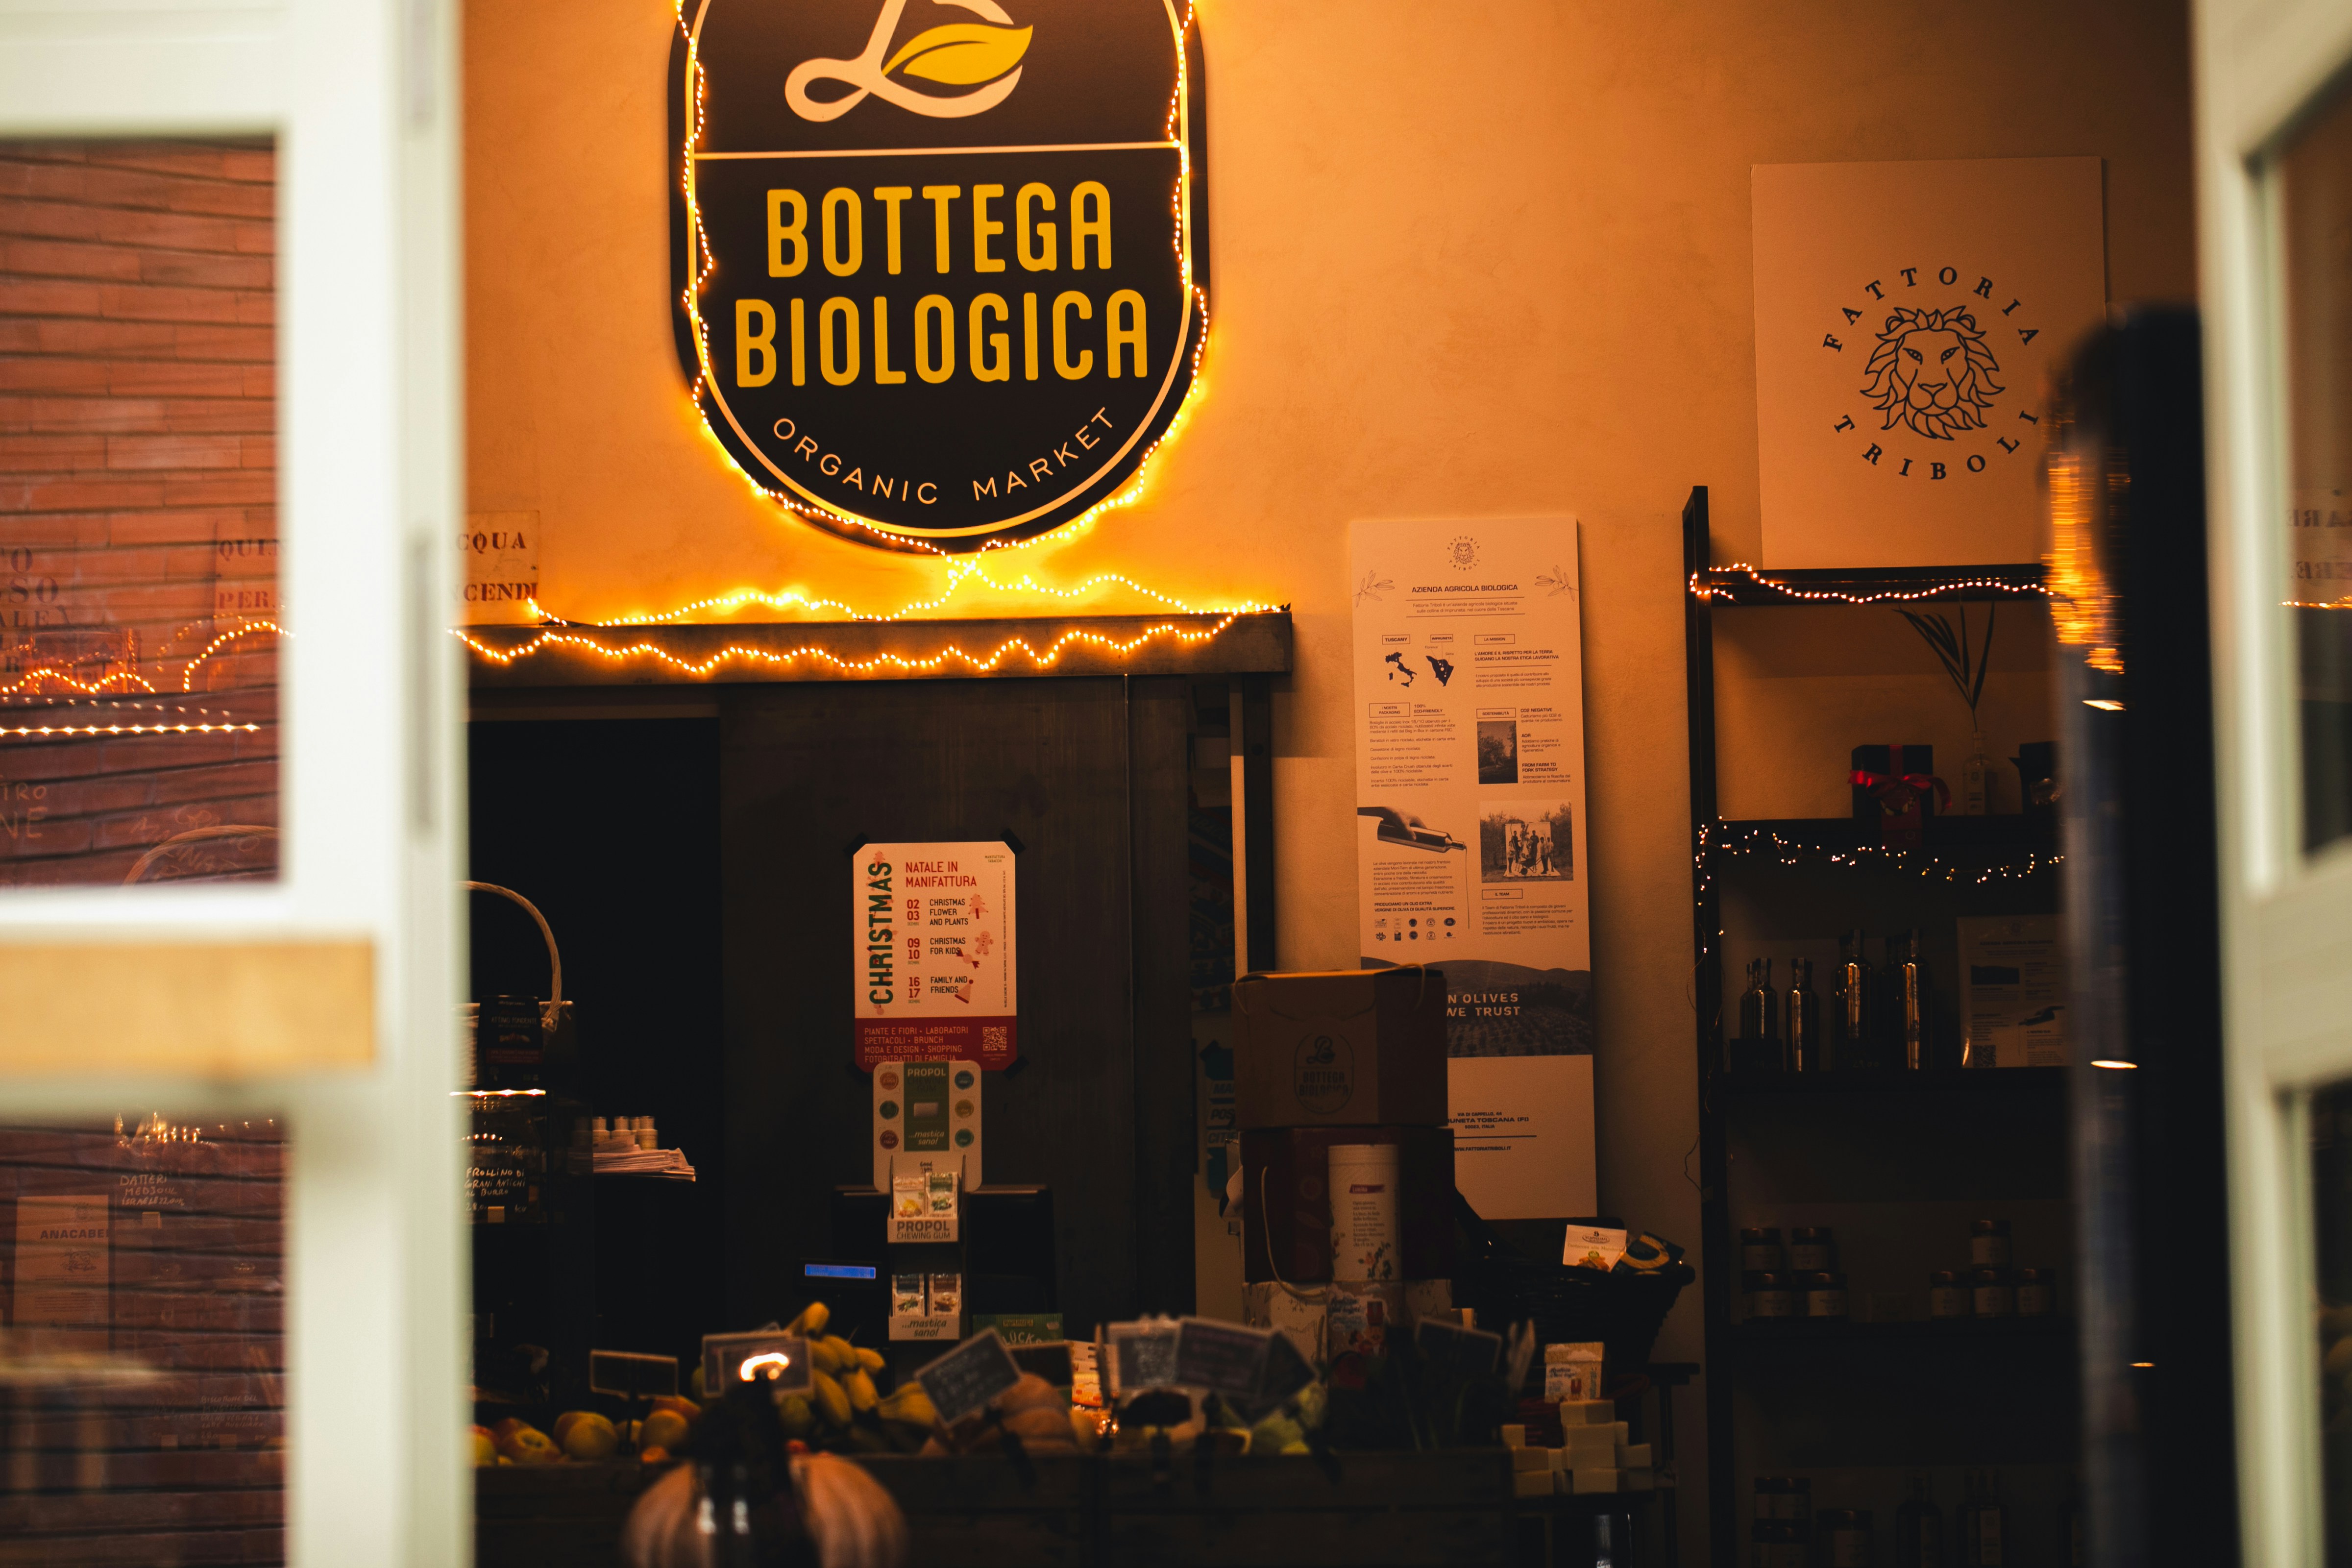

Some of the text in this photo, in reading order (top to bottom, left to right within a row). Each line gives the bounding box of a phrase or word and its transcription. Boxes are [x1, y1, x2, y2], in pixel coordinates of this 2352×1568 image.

[766, 180, 1111, 278] BOTTEGA
[1823, 267, 2039, 352] FATTORIA
[735, 290, 1148, 388] BIOLOGICA
[1834, 411, 2038, 480] TRIBOLI
[773, 408, 1115, 505] ORGANIC MARKET
[456, 532, 527, 554] CQUA
[1447, 535, 1481, 551] FATTORIA
[1448, 558, 1481, 571] TRIBOLI
[463, 582, 538, 602] CENDI
[906, 861, 958, 873] NATALE IN
[906, 876, 977, 887] MANIFATTURA
[907, 899, 920, 909] 02
[907, 911, 920, 921] 03
[868, 862, 894, 1004] CHRISTMAS
[907, 938, 920, 948] 09
[908, 950, 920, 959] 10
[909, 977, 920, 986] 16
[909, 988, 920, 998] 17
[1448, 993, 1519, 1004] N OLIVES
[1475, 1006, 1520, 1016] TRUST
[907, 1068, 946, 1077] PROPOL
[1303, 1071, 1345, 1083] BOTTEGA
[481, 1188, 508, 1197] BURRO
[897, 1221, 950, 1231] PROPOL
[39, 1228, 109, 1240] ANACABE
[914, 1328, 939, 1337] sano!
